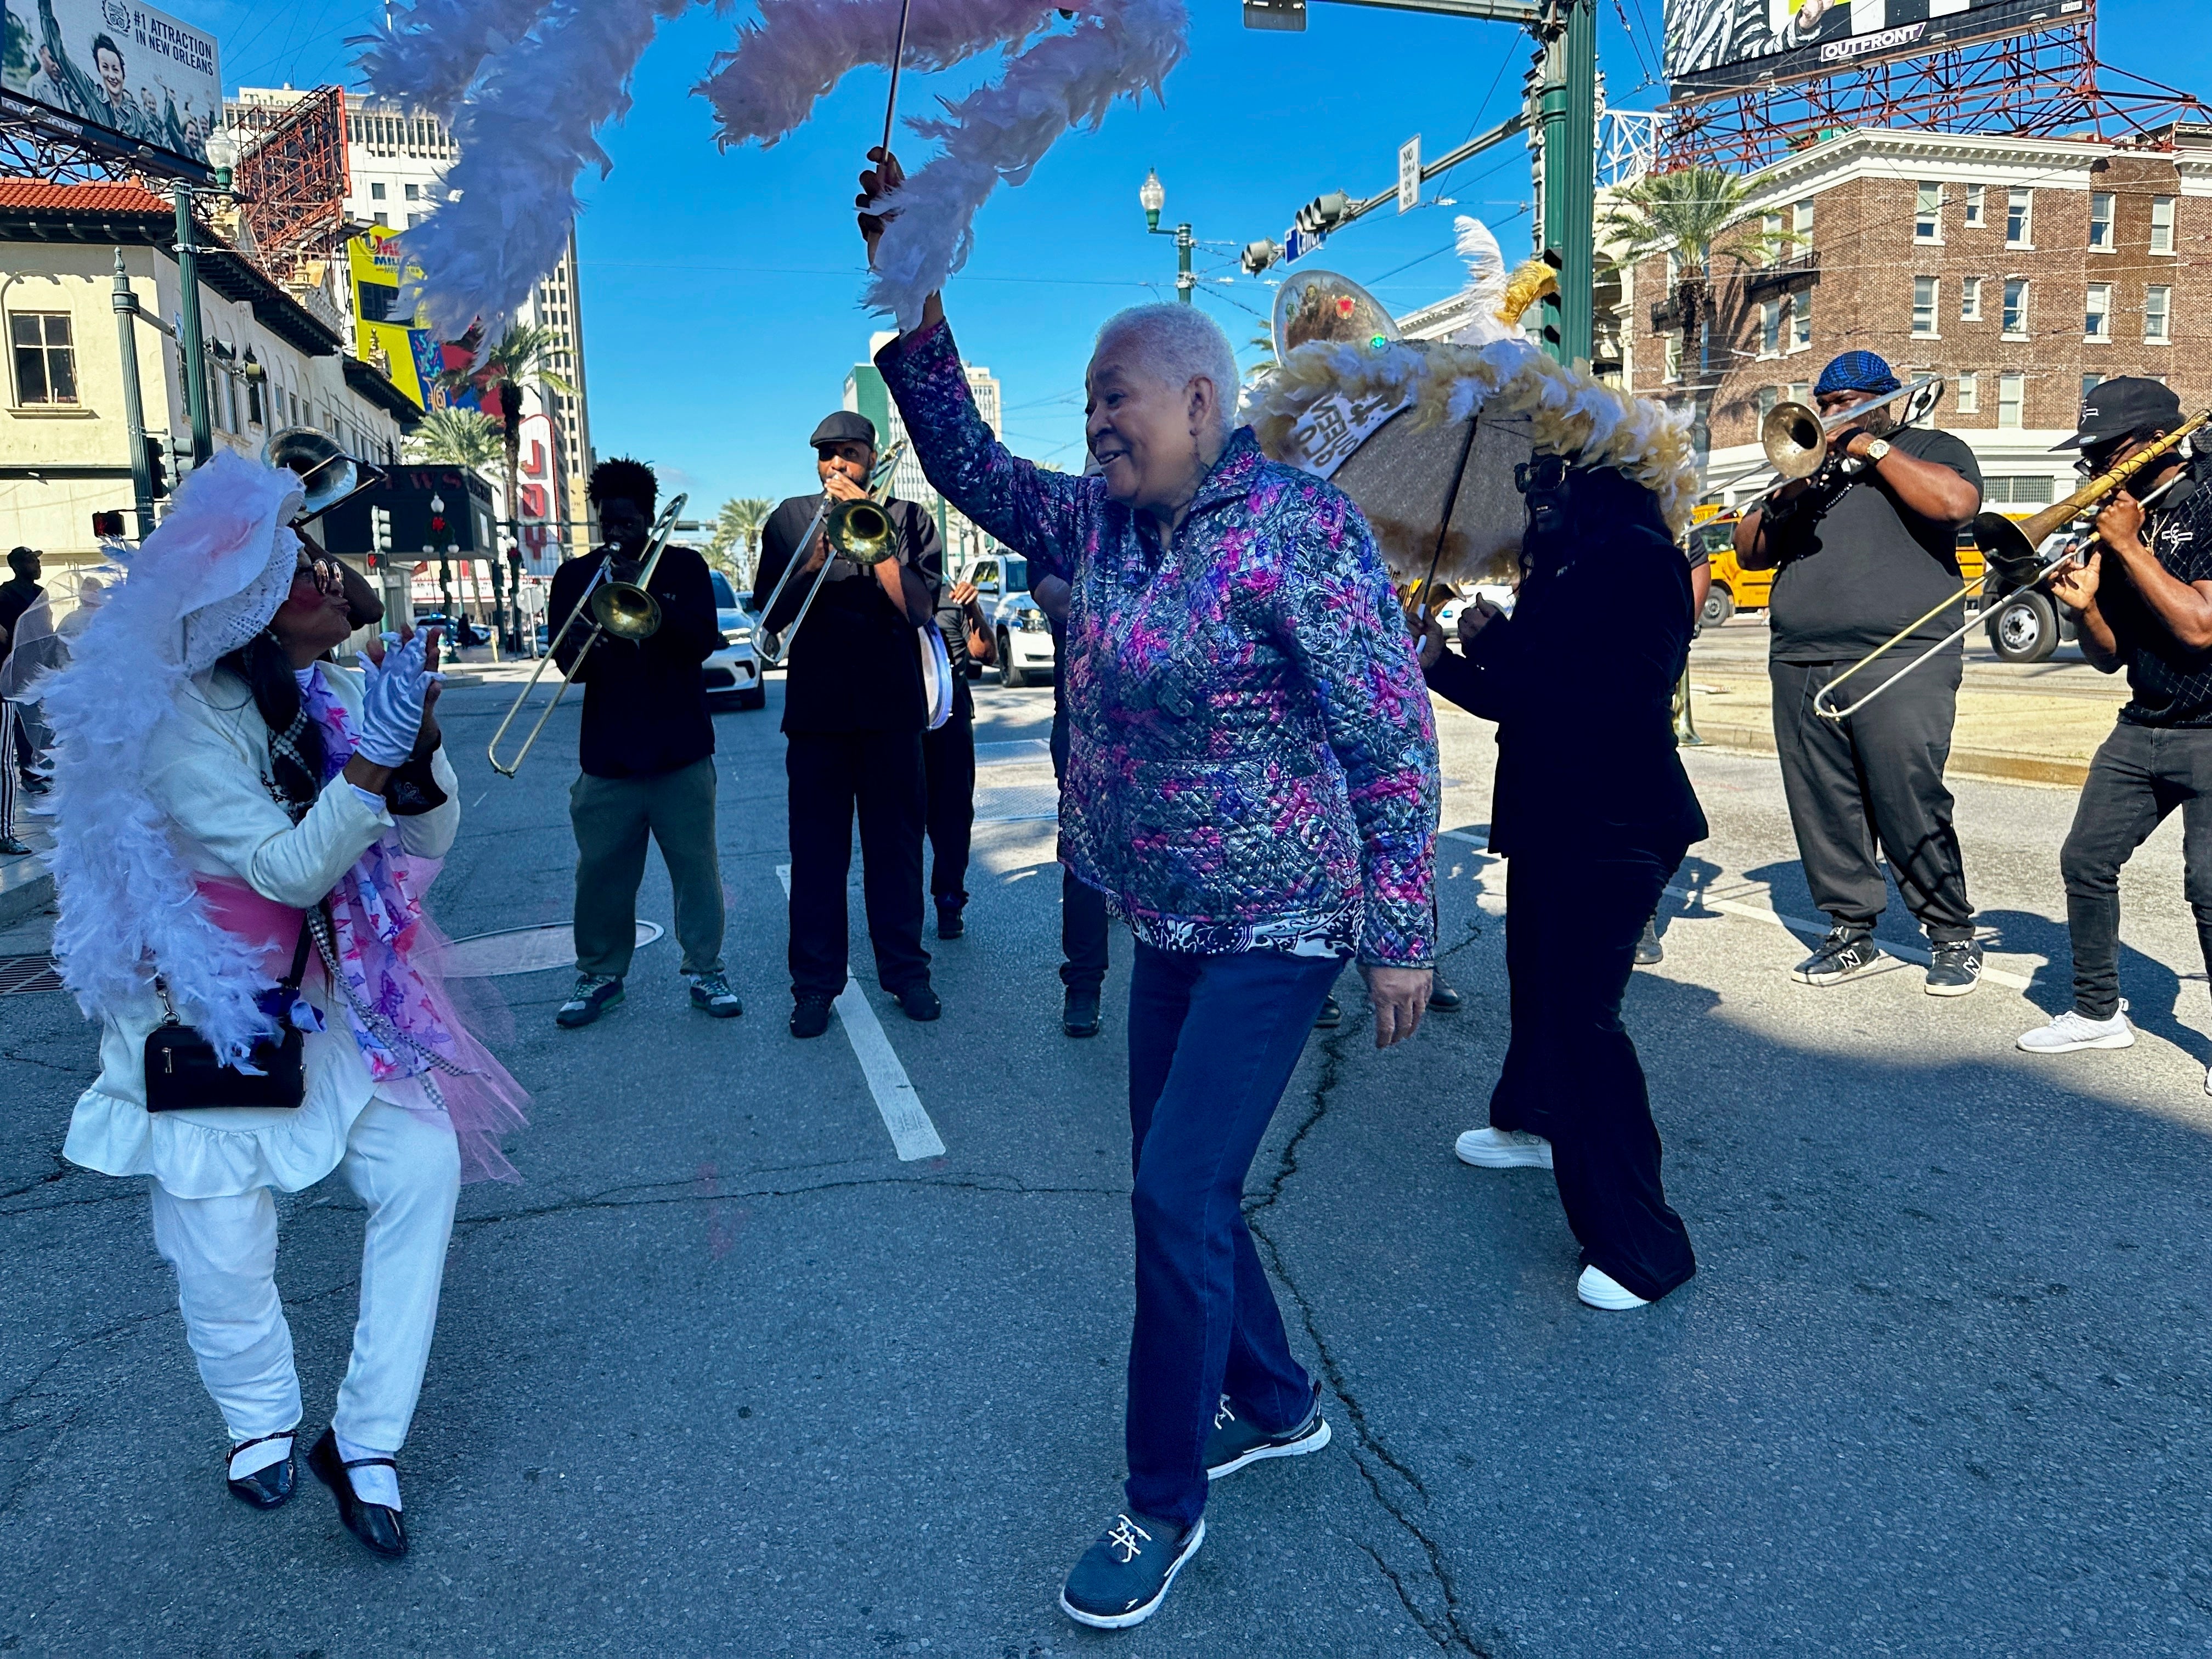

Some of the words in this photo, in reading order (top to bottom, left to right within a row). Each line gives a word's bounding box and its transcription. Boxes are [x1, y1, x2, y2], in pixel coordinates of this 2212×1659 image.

[134, 10, 146, 30] #1
[151, 18, 212, 60] ATTRACTION
[136, 29, 146, 46] IN
[149, 35, 170, 57] NEW
[173, 46, 213, 76] ORLEANS
[1825, 25, 1920, 58] OUTFRONT
[244, 94, 297, 106] Tulan
[1403, 148, 1413, 164] NO
[522, 439, 547, 560] JOY
